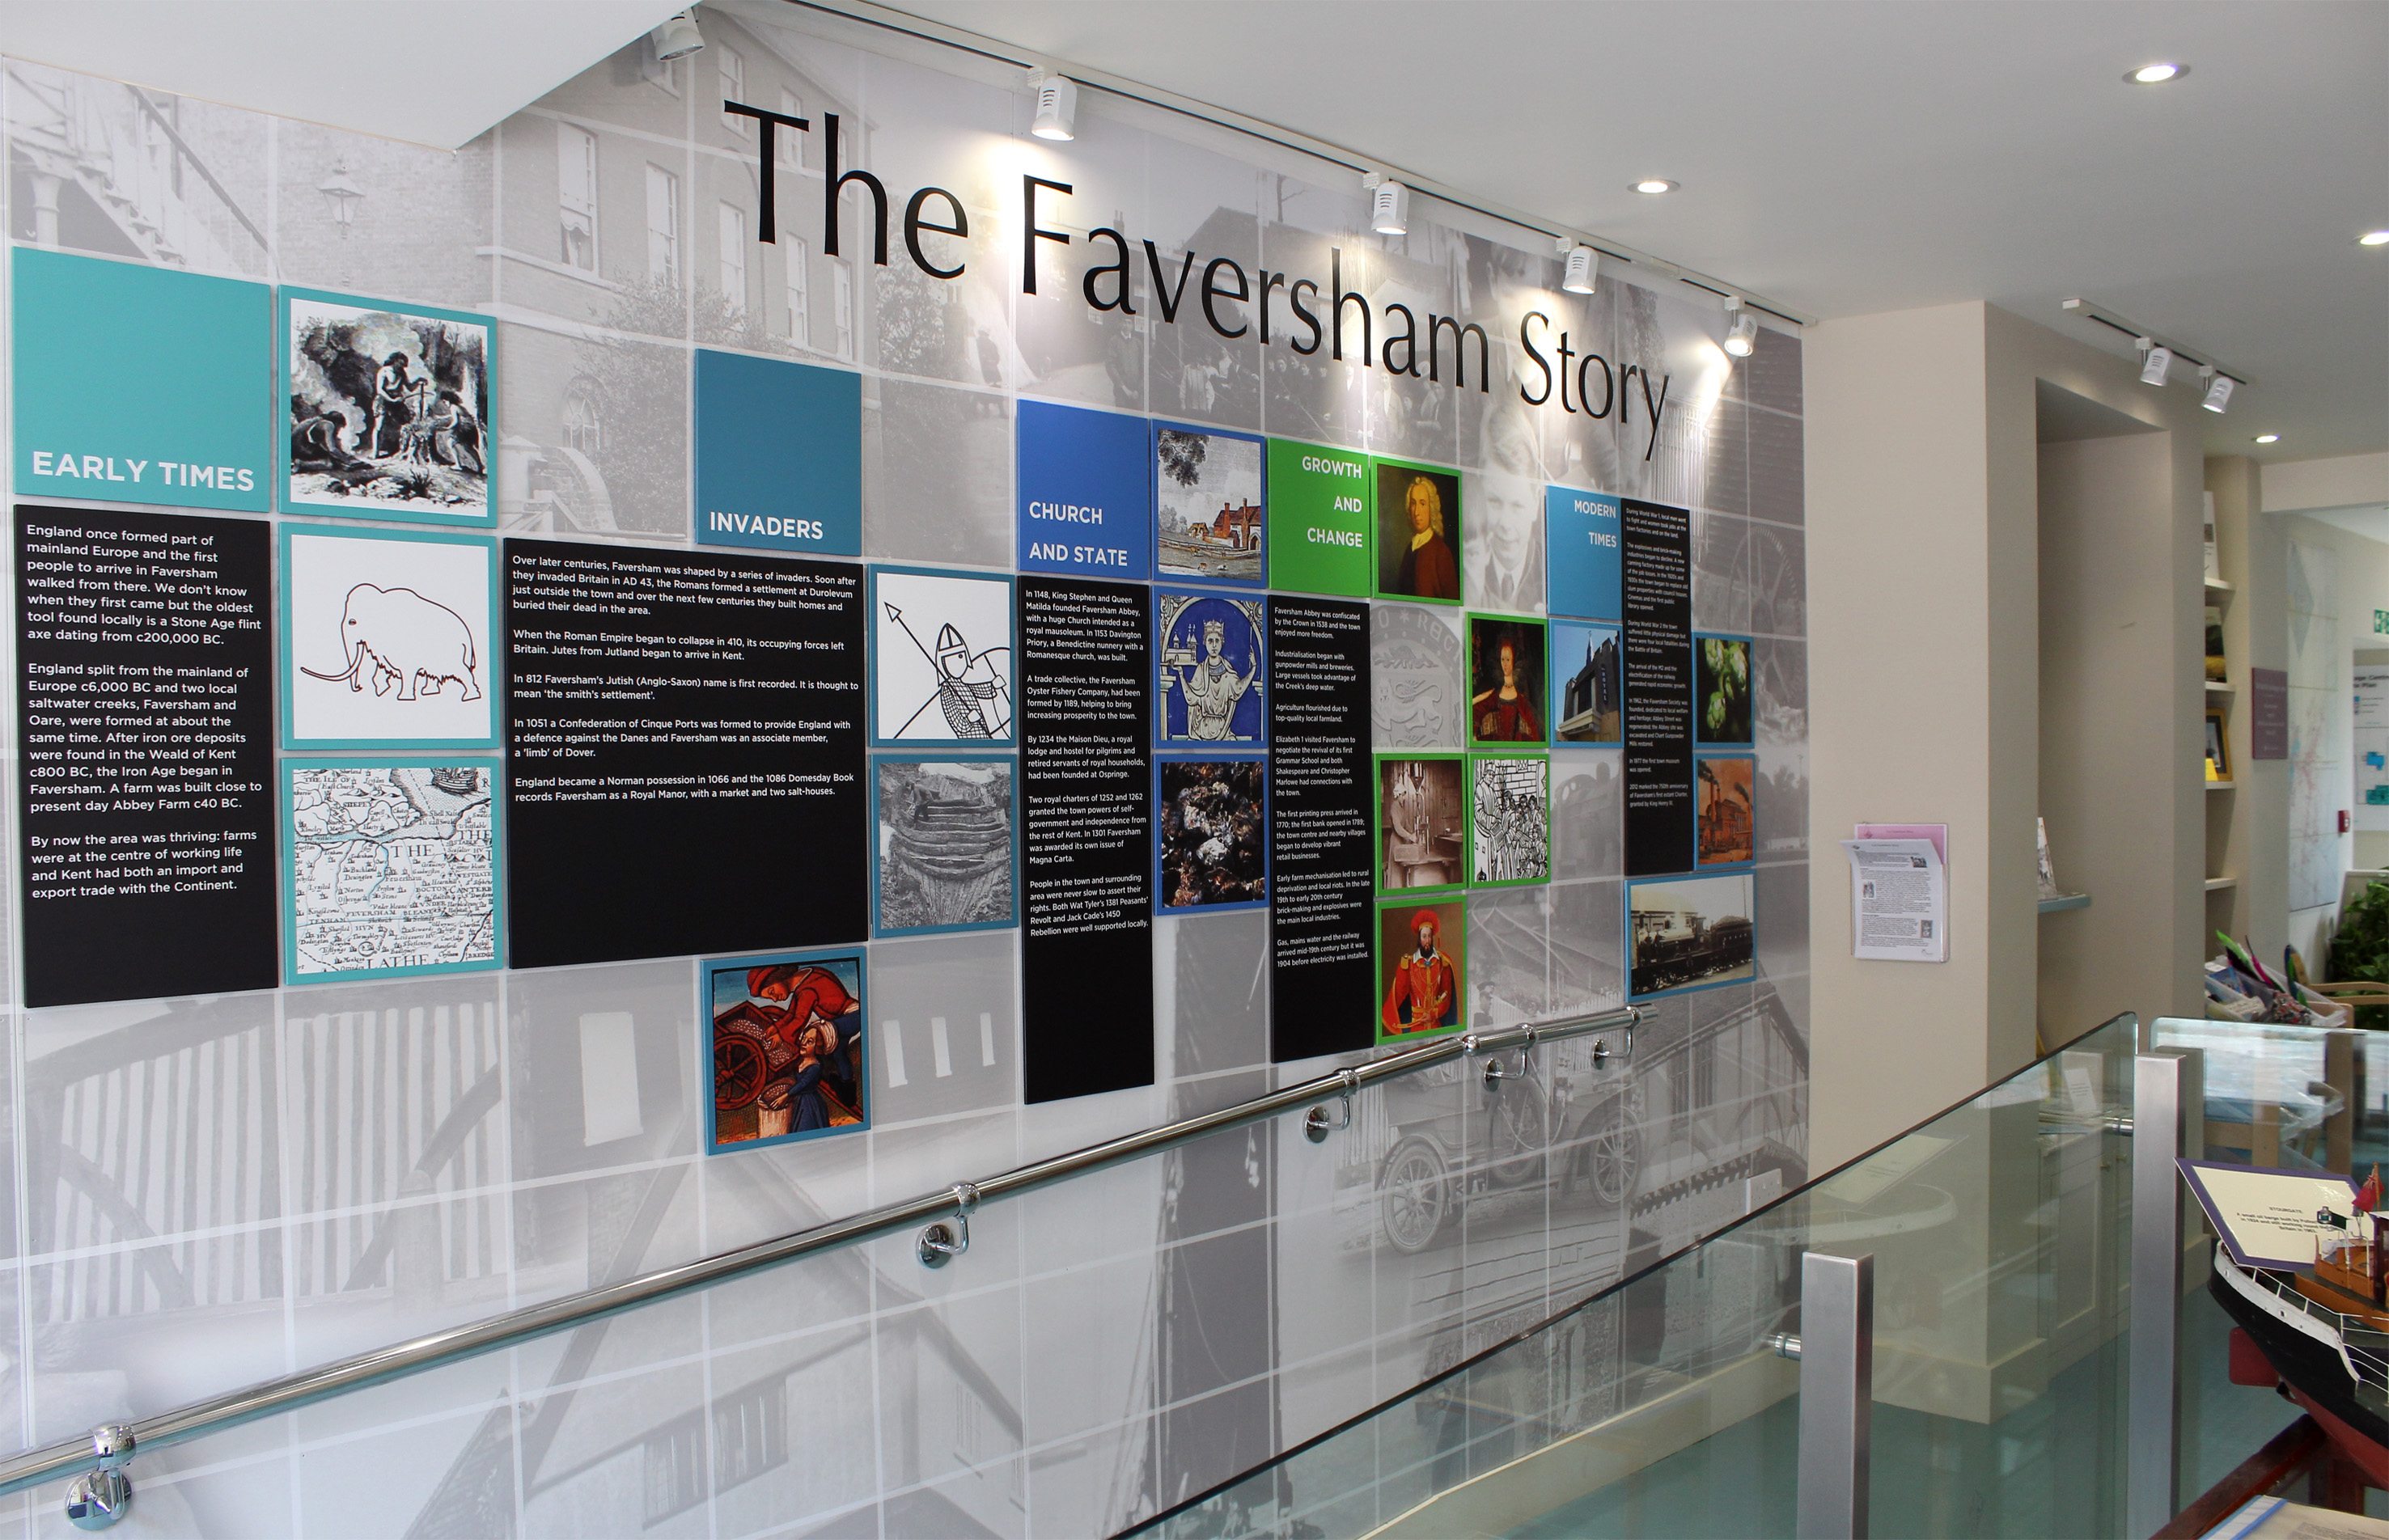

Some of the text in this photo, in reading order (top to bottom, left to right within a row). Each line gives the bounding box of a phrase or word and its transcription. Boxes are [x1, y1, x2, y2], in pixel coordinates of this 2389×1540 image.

[723, 99, 1669, 462] The Faversham Story
[32, 451, 255, 492] EARLY TIMES
[1302, 455, 1362, 480] GROWTH
[1028, 501, 1103, 526] CHURCH
[1333, 495, 1362, 514] AND
[1574, 499, 1616, 518] MODERN
[710, 510, 824, 541] INVADERS
[27, 524, 214, 546] England once formed part of
[1306, 527, 1363, 548] CHANGE
[1588, 531, 1617, 548] TIMES
[27, 542, 218, 563] mainland Europe and the first
[1028, 542, 1129, 567] AND STATE
[27, 561, 218, 579] people to arrive in Faversham
[512, 555, 537, 565] Over
[539, 556, 562, 567] later
[563, 560, 610, 571] centuries,
[612, 561, 662, 573] Faversham
[663, 566, 681, 575] was
[683, 566, 716, 578] shaped
[718, 568, 729, 579] by
[738, 570, 763, 580] series
[765, 571, 774, 581] of
[776, 572, 813, 583] invaders.
[815, 574, 836, 585] Soon
[837, 576, 857, 586] after
[1026, 590, 1133, 603] In 1148, King Stephen and Queen
[1026, 602, 1141, 617] Matilda founded Faversham Abbey,
[1274, 607, 1303, 616] Faversham
[1303, 609, 1321, 619] Abbey
[1332, 611, 1361, 620] confiscated
[1274, 628, 1296, 637] enjoyed
[1275, 649, 1316, 659] Industrialisation
[1316, 652, 1333, 661] began
[28, 662, 249, 678] England split from the mainland of
[515, 792, 553, 802] records
[555, 791, 607, 801] Faversham
[608, 792, 620, 800] as
[621, 792, 628, 800] a
[630, 789, 656, 801] Royal
[658, 789, 688, 799] Manor,
[690, 789, 709, 798] with
[719, 788, 750, 798] market
[751, 787, 768, 797] and
[769, 788, 786, 797] two
[787, 786, 836, 796] salt-houses.
[1287, 810, 1298, 818] first
[31, 830, 257, 848] By now the area was thriving: farms
[390, 843, 434, 858] THE
[1030, 879, 1053, 889] People
[1054, 878, 1061, 886] in
[1061, 878, 1074, 886] the
[1091, 876, 1104, 884] and
[1104, 874, 1142, 883] surrounding
[1030, 919, 1149, 937] Rebellion were well supported locally.
[1277, 959, 1291, 967] 1904
[1291, 958, 1309, 966] before
[1310, 955, 1336, 964] electricity
